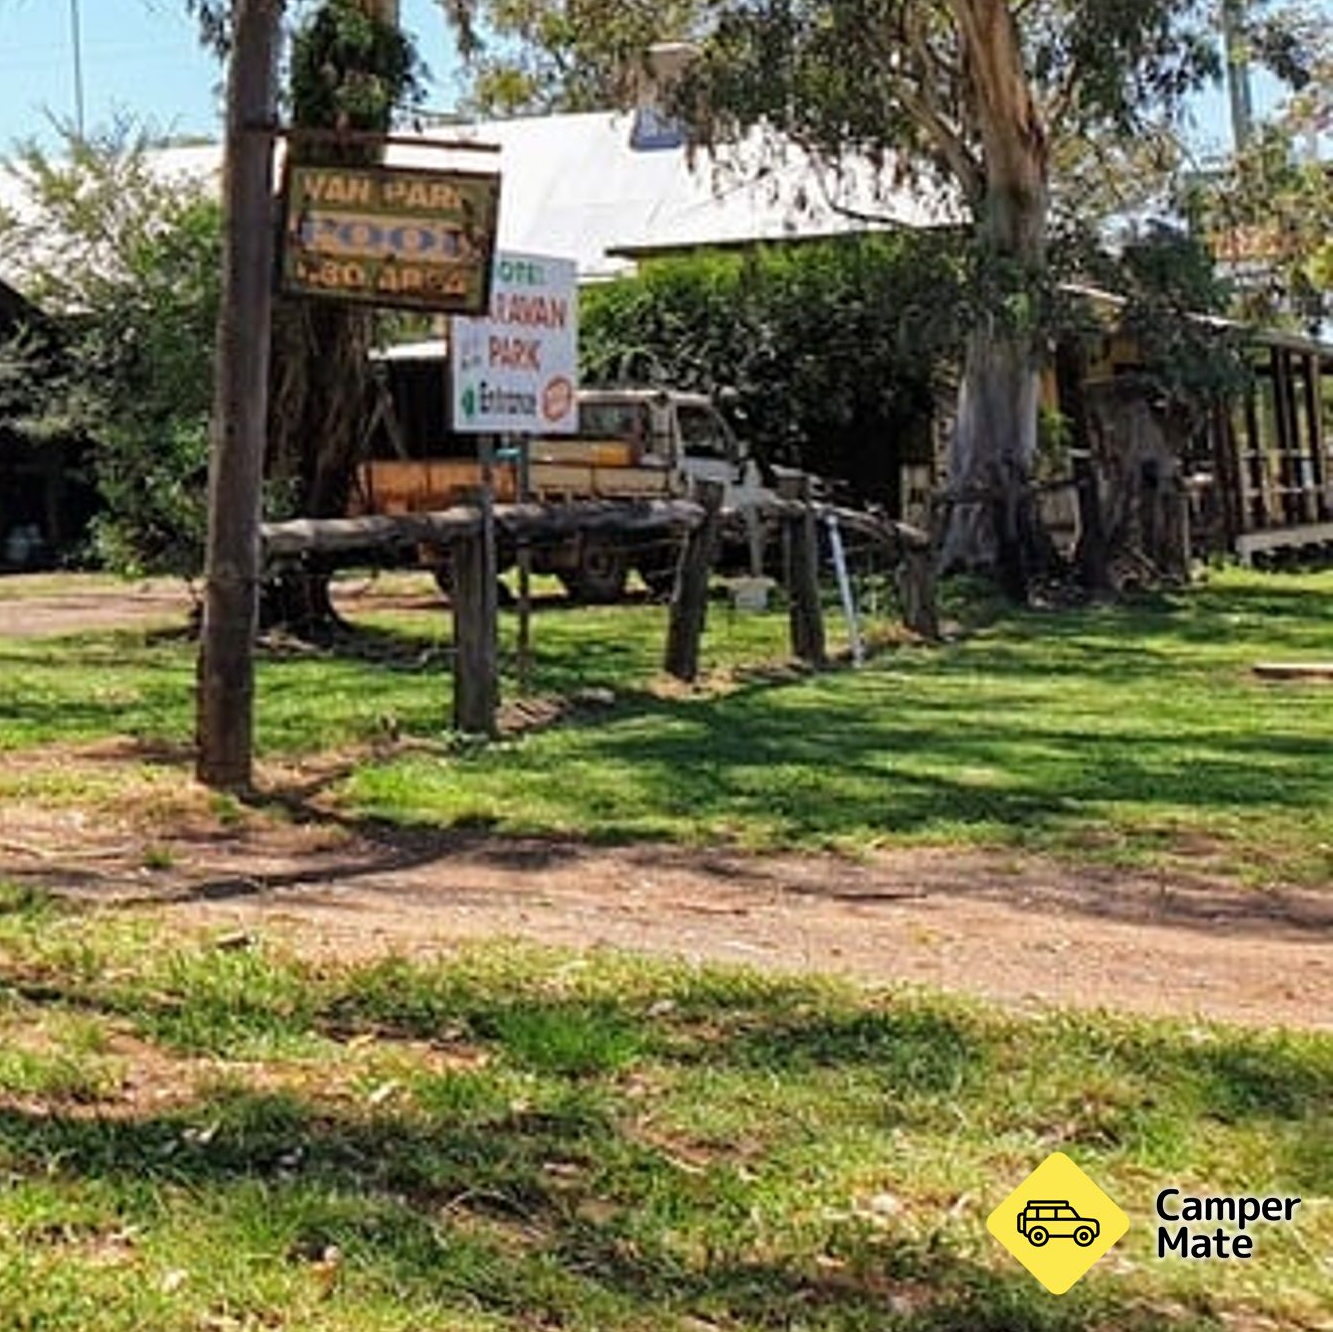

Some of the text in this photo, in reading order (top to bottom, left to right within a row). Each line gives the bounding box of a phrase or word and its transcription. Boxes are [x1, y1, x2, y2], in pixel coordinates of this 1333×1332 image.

[304, 175, 371, 203] VAN
[496, 259, 547, 286] OTEL
[488, 334, 542, 371] PARK
[479, 379, 538, 415] Entrance
